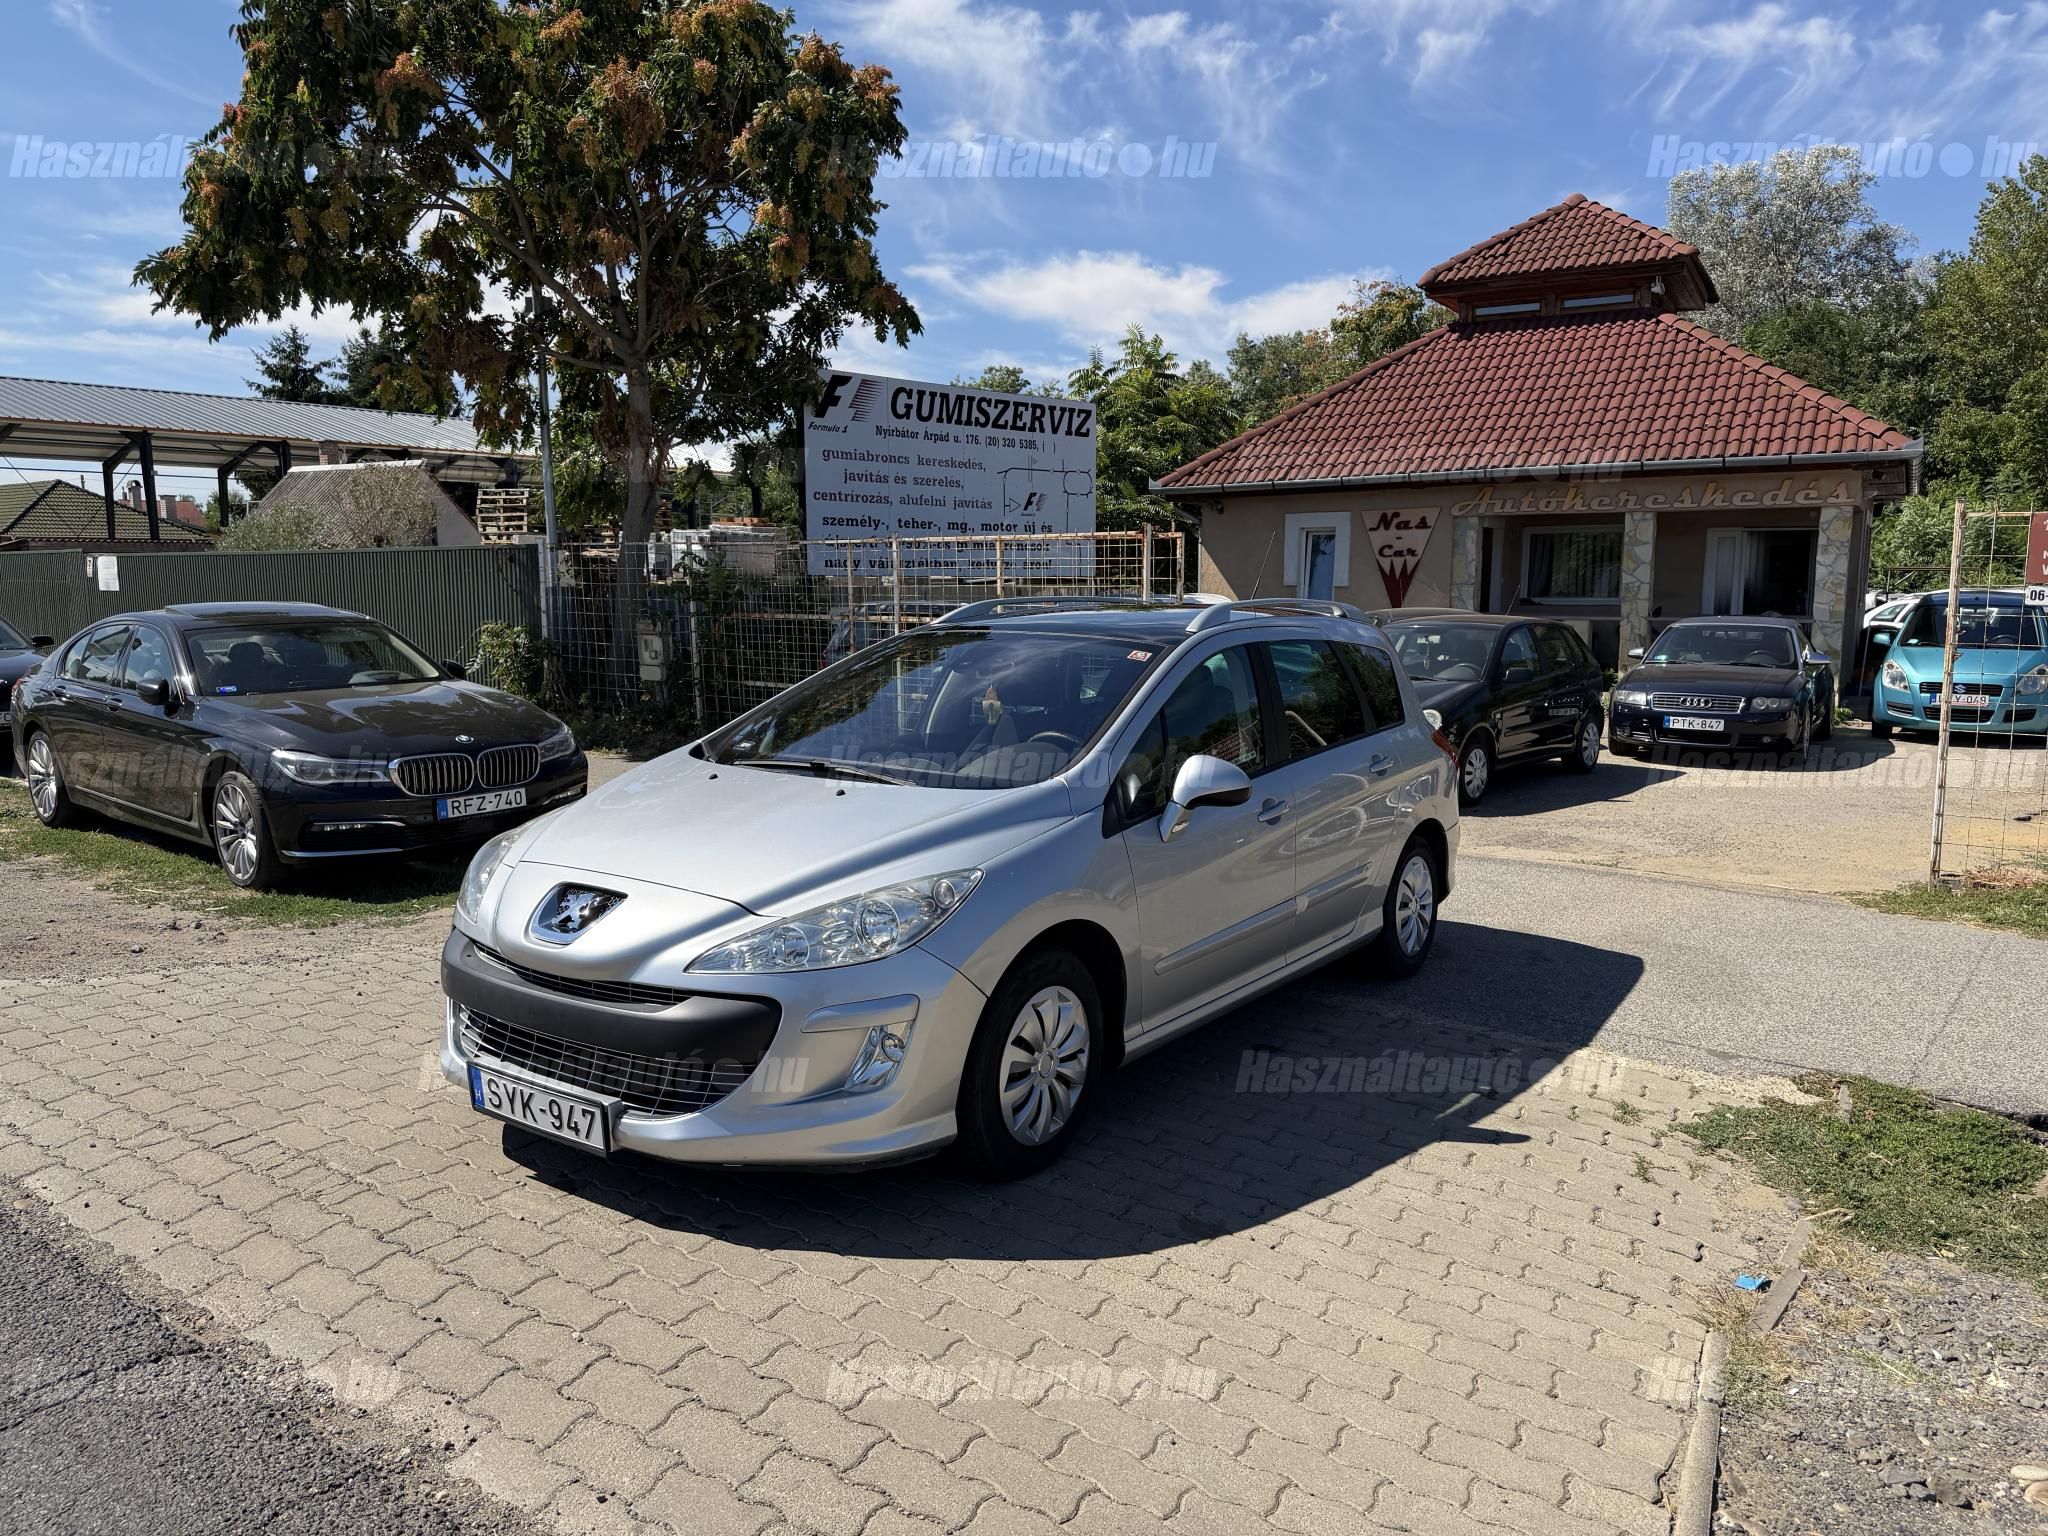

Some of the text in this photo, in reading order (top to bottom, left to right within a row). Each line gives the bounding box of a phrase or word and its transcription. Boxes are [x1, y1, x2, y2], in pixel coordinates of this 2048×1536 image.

[890, 386, 1092, 438] GUMISZERVIZ
[808, 421, 848, 433] Formula 1
[923, 426, 950, 444] Árpád
[953, 435, 962, 443] u.
[965, 434, 982, 446] 176.
[984, 435, 1001, 449] (20)
[1002, 437, 1016, 449] 320
[822, 449, 987, 473] gumiabroncs kereskedés,
[893, 472, 908, 486] és
[912, 474, 965, 491] szerelés,
[898, 493, 947, 508] alufelni
[1451, 478, 1855, 517] Autókereskedés
[822, 514, 890, 531] személy-,
[897, 515, 942, 532] teher-,
[980, 520, 1018, 534] motor
[1023, 519, 1037, 537] új
[1040, 522, 1054, 534] és
[1368, 511, 1433, 532] Nas
[1378, 544, 1419, 558] Car
[1671, 718, 1723, 731] PTK-847
[451, 790, 523, 816] RFZ-740
[486, 1077, 597, 1141] SYK-947
